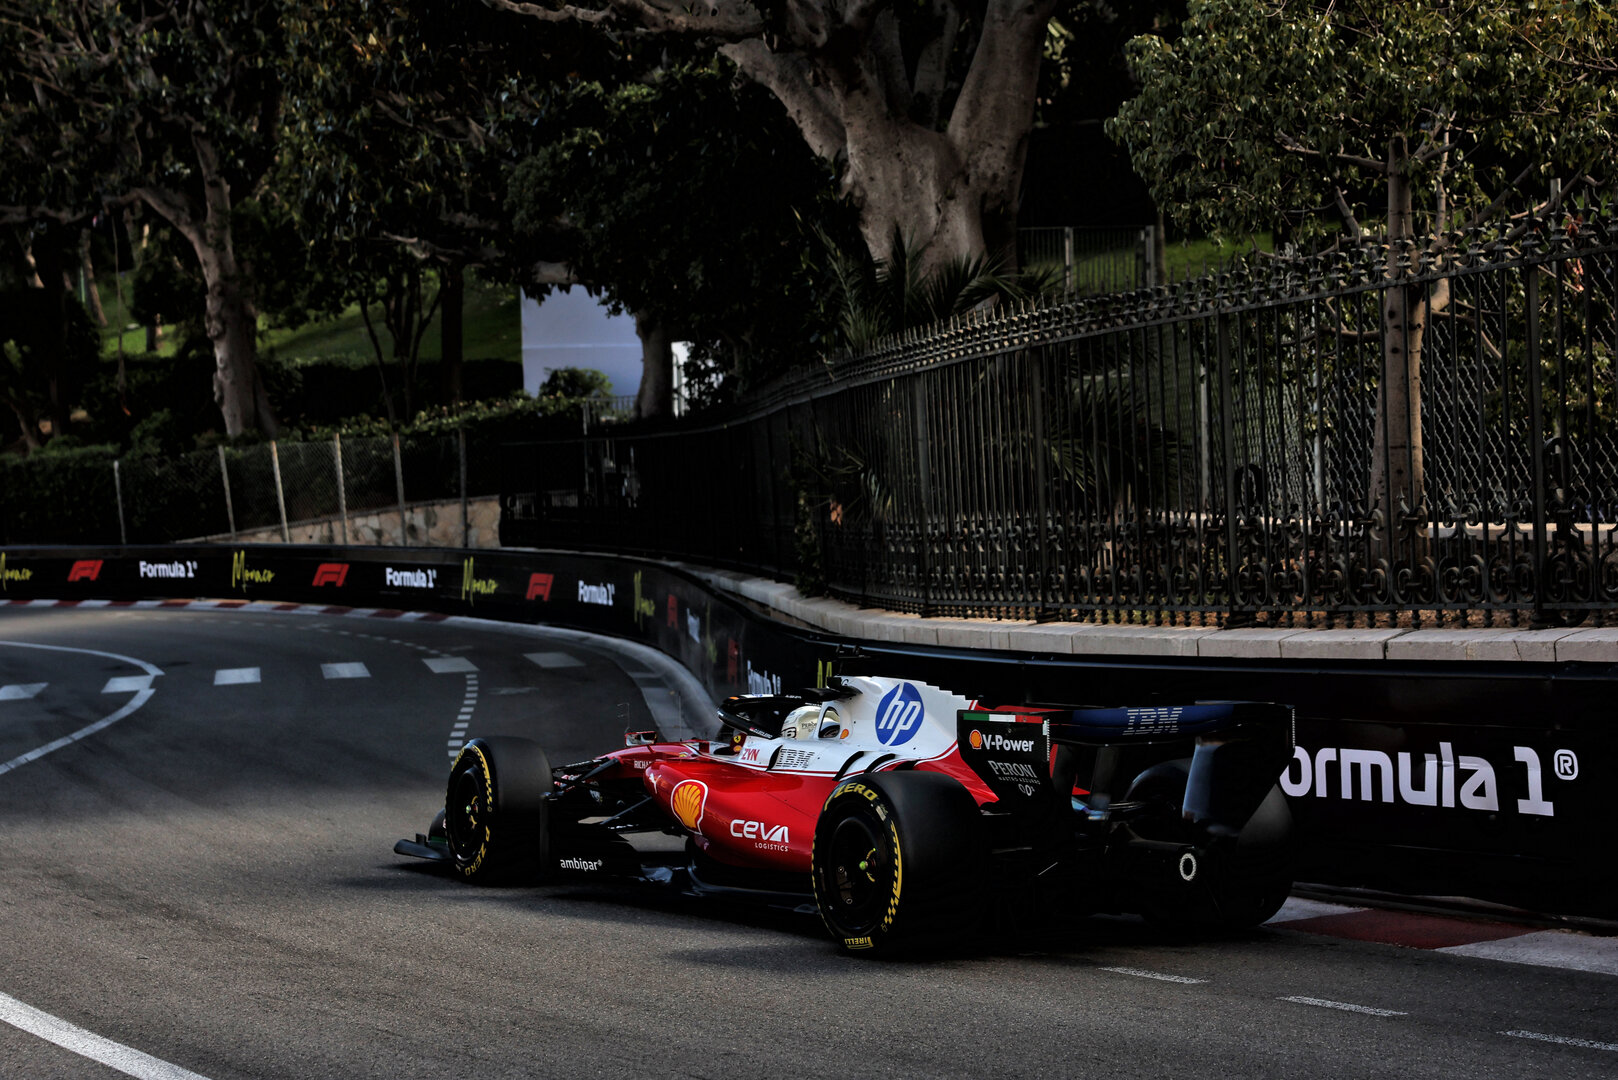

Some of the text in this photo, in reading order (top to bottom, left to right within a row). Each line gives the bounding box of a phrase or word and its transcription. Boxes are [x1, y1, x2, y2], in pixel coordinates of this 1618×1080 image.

[139, 560, 186, 578] Formula
[385, 567, 427, 588] Formula
[877, 682, 924, 746] hp
[1122, 707, 1183, 735] IBM
[982, 734, 1035, 752] V-Power
[741, 748, 760, 761] ZYN
[776, 748, 815, 769] IBM
[988, 760, 1038, 778] PERONI
[1279, 741, 1500, 812] ormula
[833, 782, 879, 801] ZERO
[754, 842, 789, 852] LOGISTICS
[560, 857, 599, 872] ambipar
